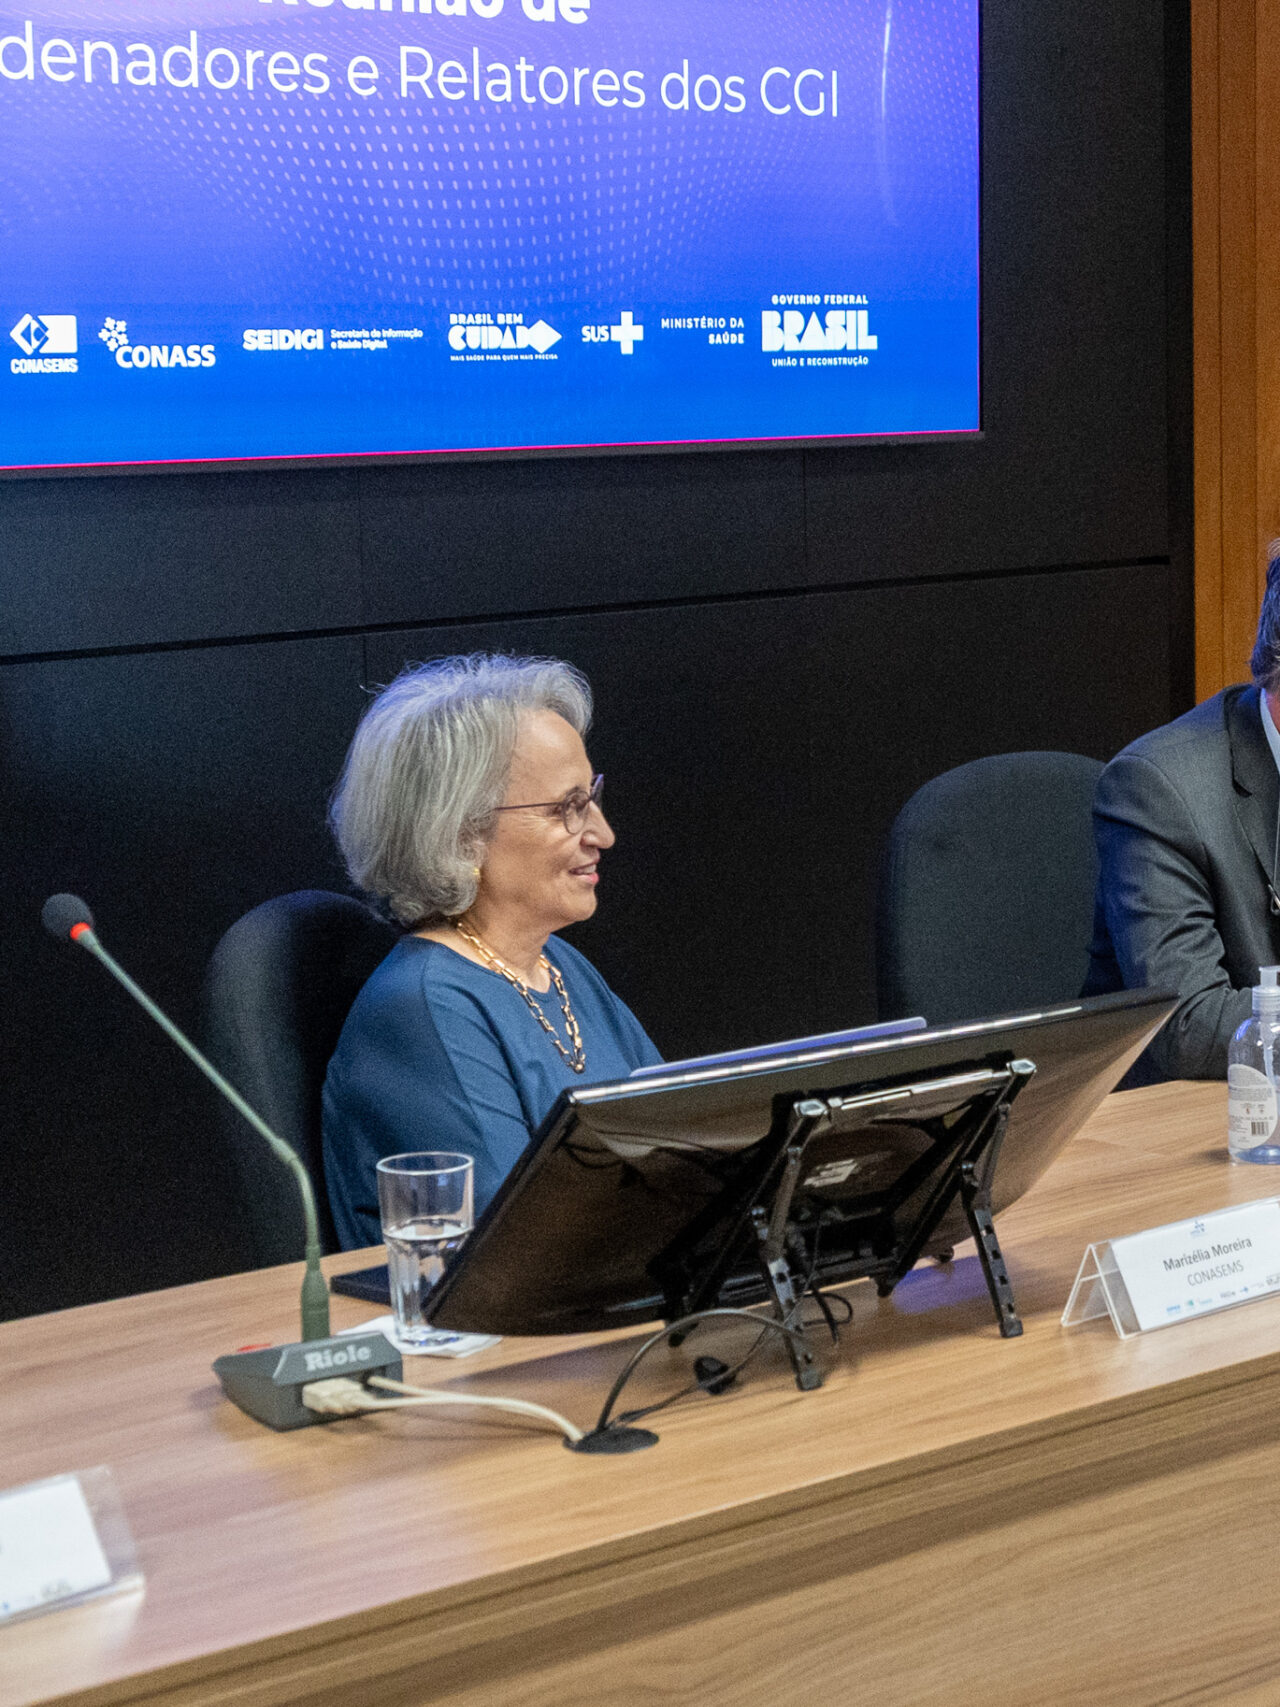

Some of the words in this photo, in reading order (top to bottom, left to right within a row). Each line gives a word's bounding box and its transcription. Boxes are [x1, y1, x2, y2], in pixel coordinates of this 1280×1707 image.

[0, 20, 331, 94] denadores
[347, 55, 380, 96] e
[400, 45, 646, 109] Relatores
[660, 59, 747, 113] dos
[759, 66, 838, 117] CGI
[771, 294, 821, 305] GOVERNO
[824, 294, 869, 305] FEDERAL
[450, 313, 495, 325] BRASIL
[497, 313, 524, 324] BEM
[661, 315, 726, 329] MINISTÉRIO
[730, 317, 745, 328] DA
[242, 328, 324, 351] SEIDIGI
[330, 328, 370, 339] Secretaria
[371, 328, 382, 338] de
[581, 325, 609, 342] SUS
[708, 332, 745, 345] SAÚDE
[761, 310, 878, 352] BRASIL
[115, 344, 217, 369] CONASS
[771, 356, 798, 367] UNIÃO
[799, 357, 805, 366] E
[806, 355, 869, 367] RECONSTRUÇÃO
[10, 358, 79, 374] CONASEMS
[1162, 1248, 1211, 1272] Marizélia
[1211, 1238, 1253, 1257] Moreira
[1187, 1259, 1245, 1287] CONASEMS
[304, 1345, 373, 1373] Riole
